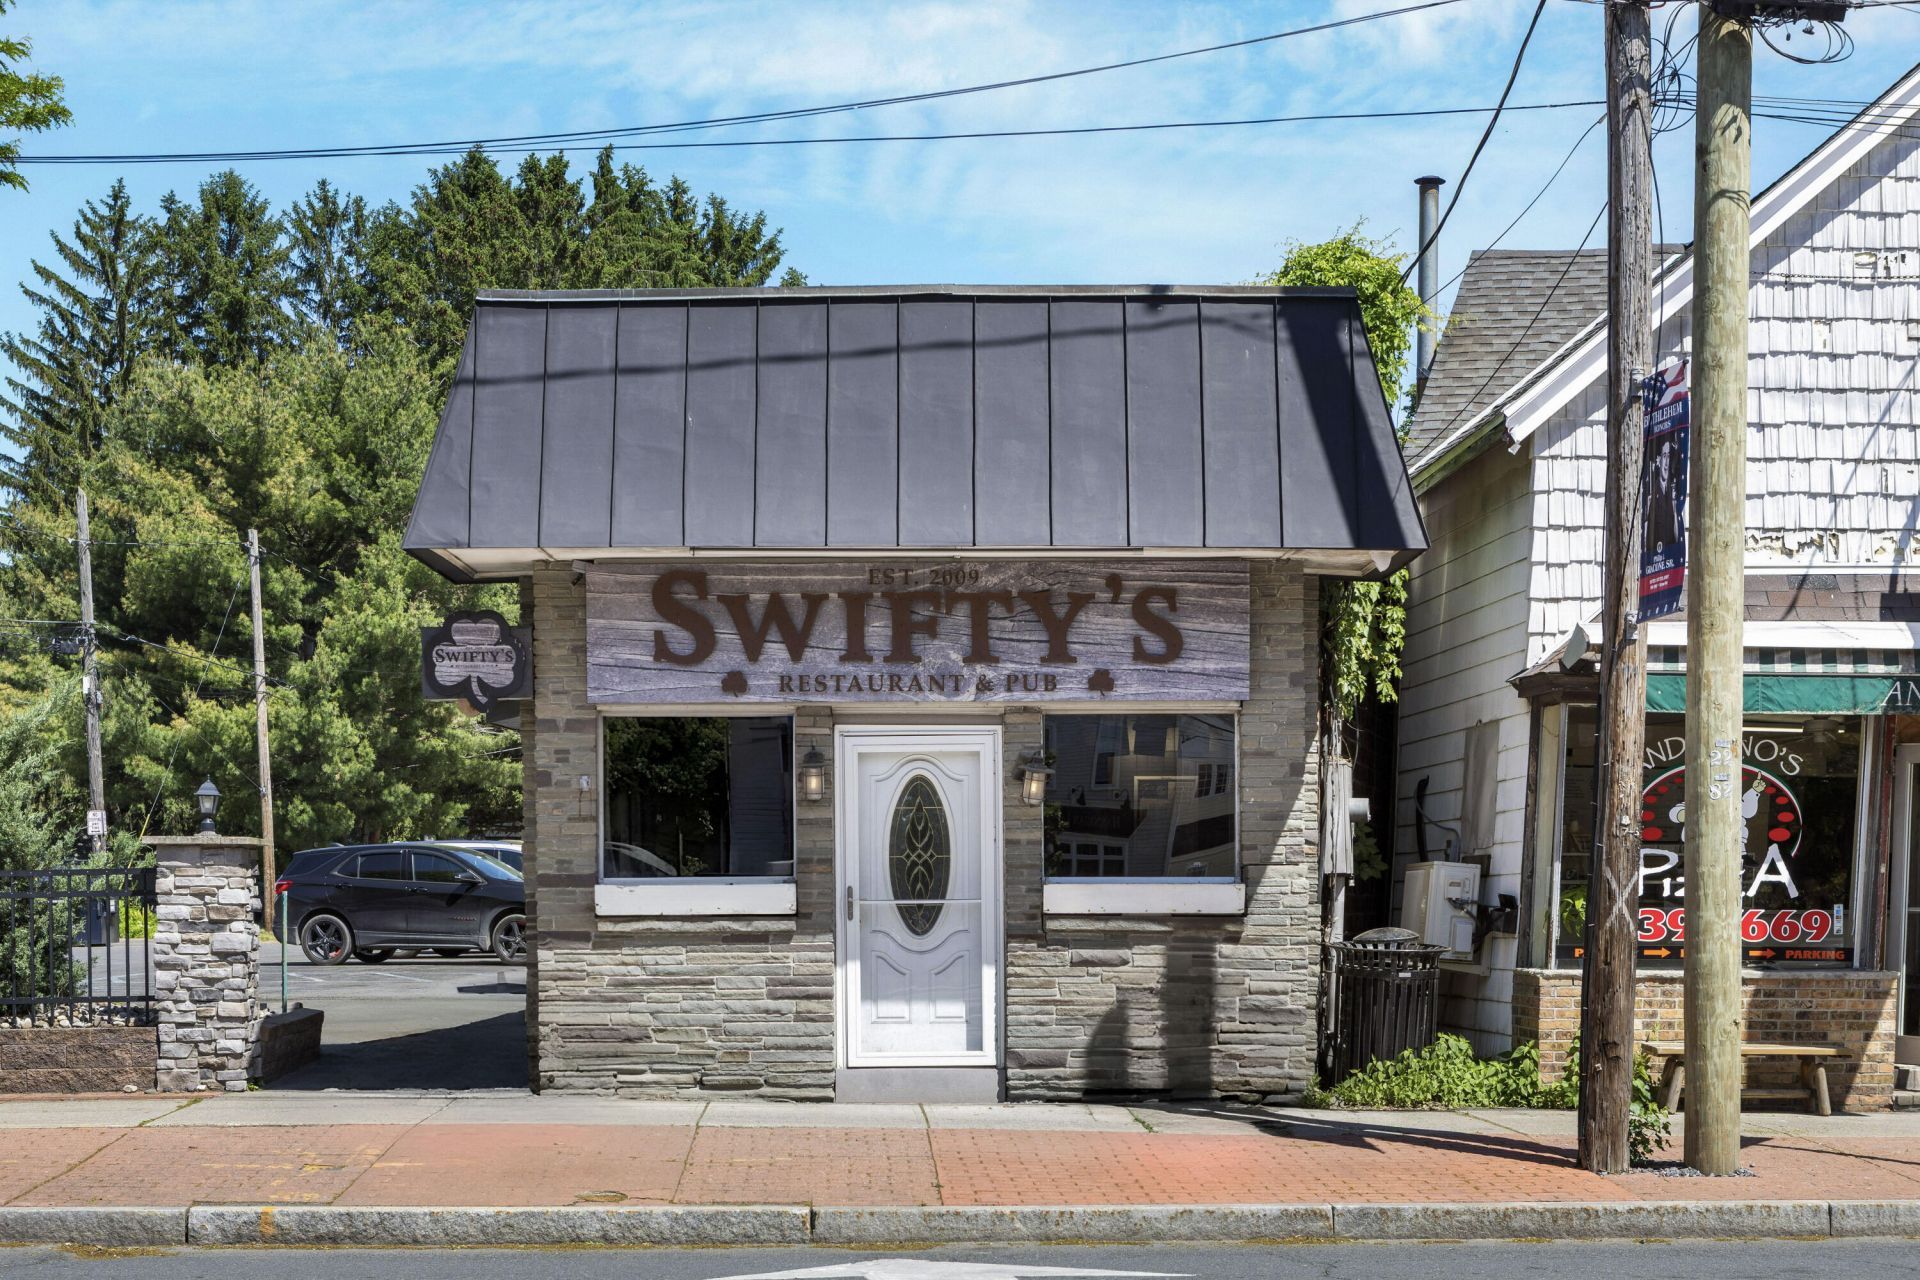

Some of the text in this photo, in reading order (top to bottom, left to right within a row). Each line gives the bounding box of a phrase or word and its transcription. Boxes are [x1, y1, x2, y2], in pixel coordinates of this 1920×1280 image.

[868, 568, 979, 586] EST. 2009
[651, 570, 1185, 666] SWIFTY'S
[435, 648, 514, 663] SWIFTY'S
[779, 673, 1058, 693] RESTAURANT & PUB
[1785, 950, 1845, 960] PARKING
